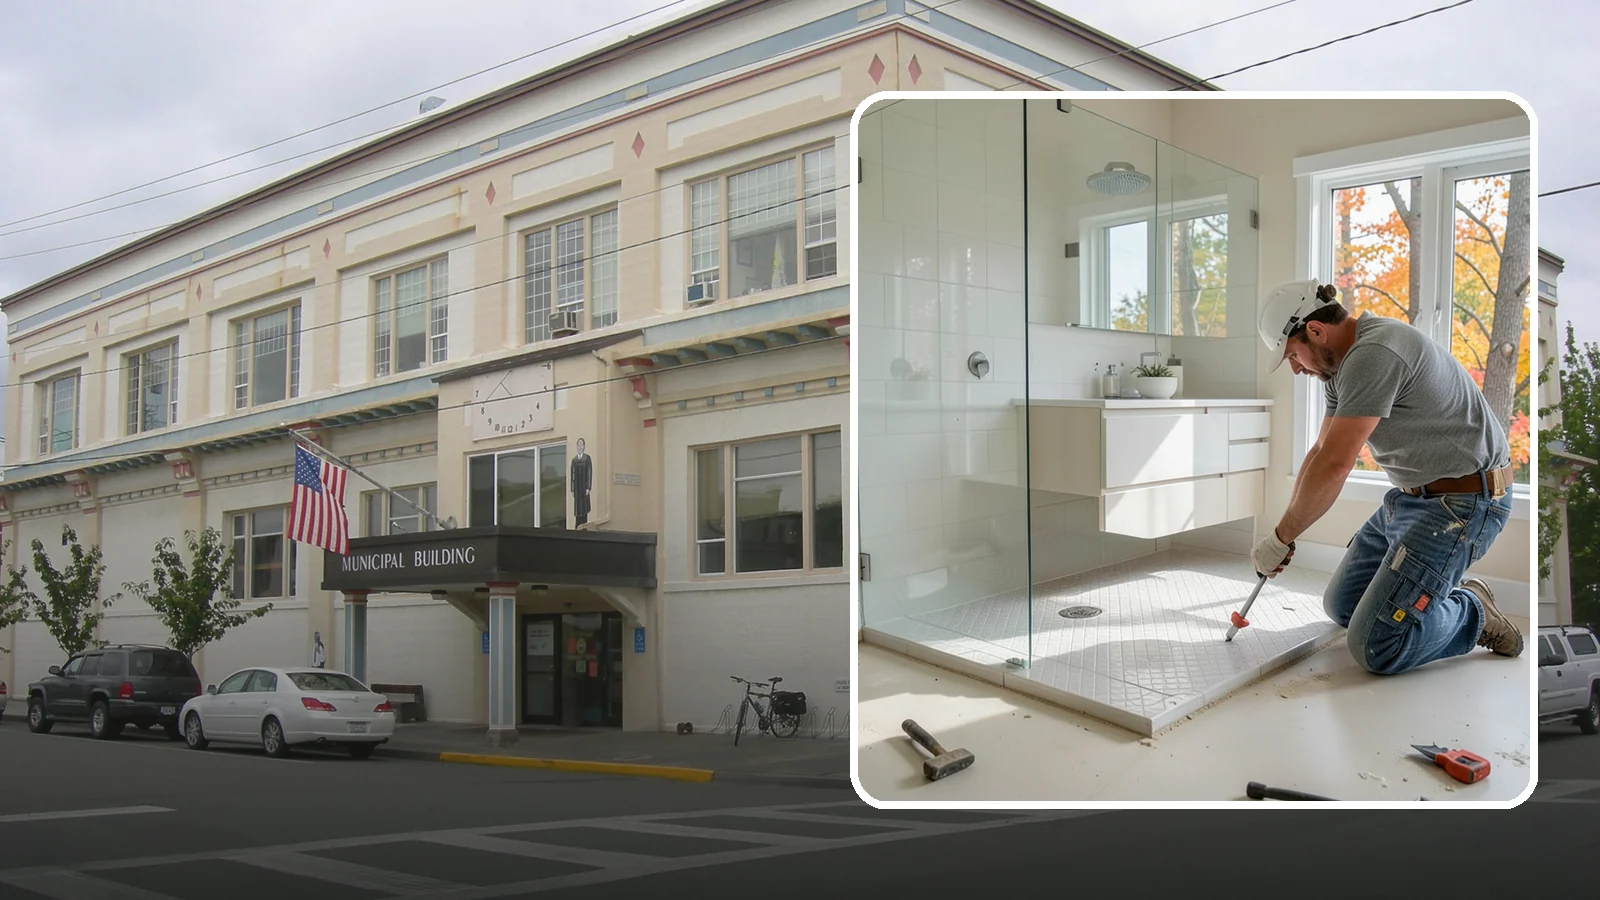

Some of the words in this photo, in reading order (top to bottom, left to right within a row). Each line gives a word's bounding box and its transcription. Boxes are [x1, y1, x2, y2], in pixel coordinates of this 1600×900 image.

[475, 390, 479, 398] 7
[536, 402, 540, 410] 4
[480, 407, 484, 415] 8
[488, 418, 492, 426] 9
[529, 414, 533, 422] 3
[342, 552, 405, 572] MUNICIPAL
[414, 546, 475, 567] BUILDING
